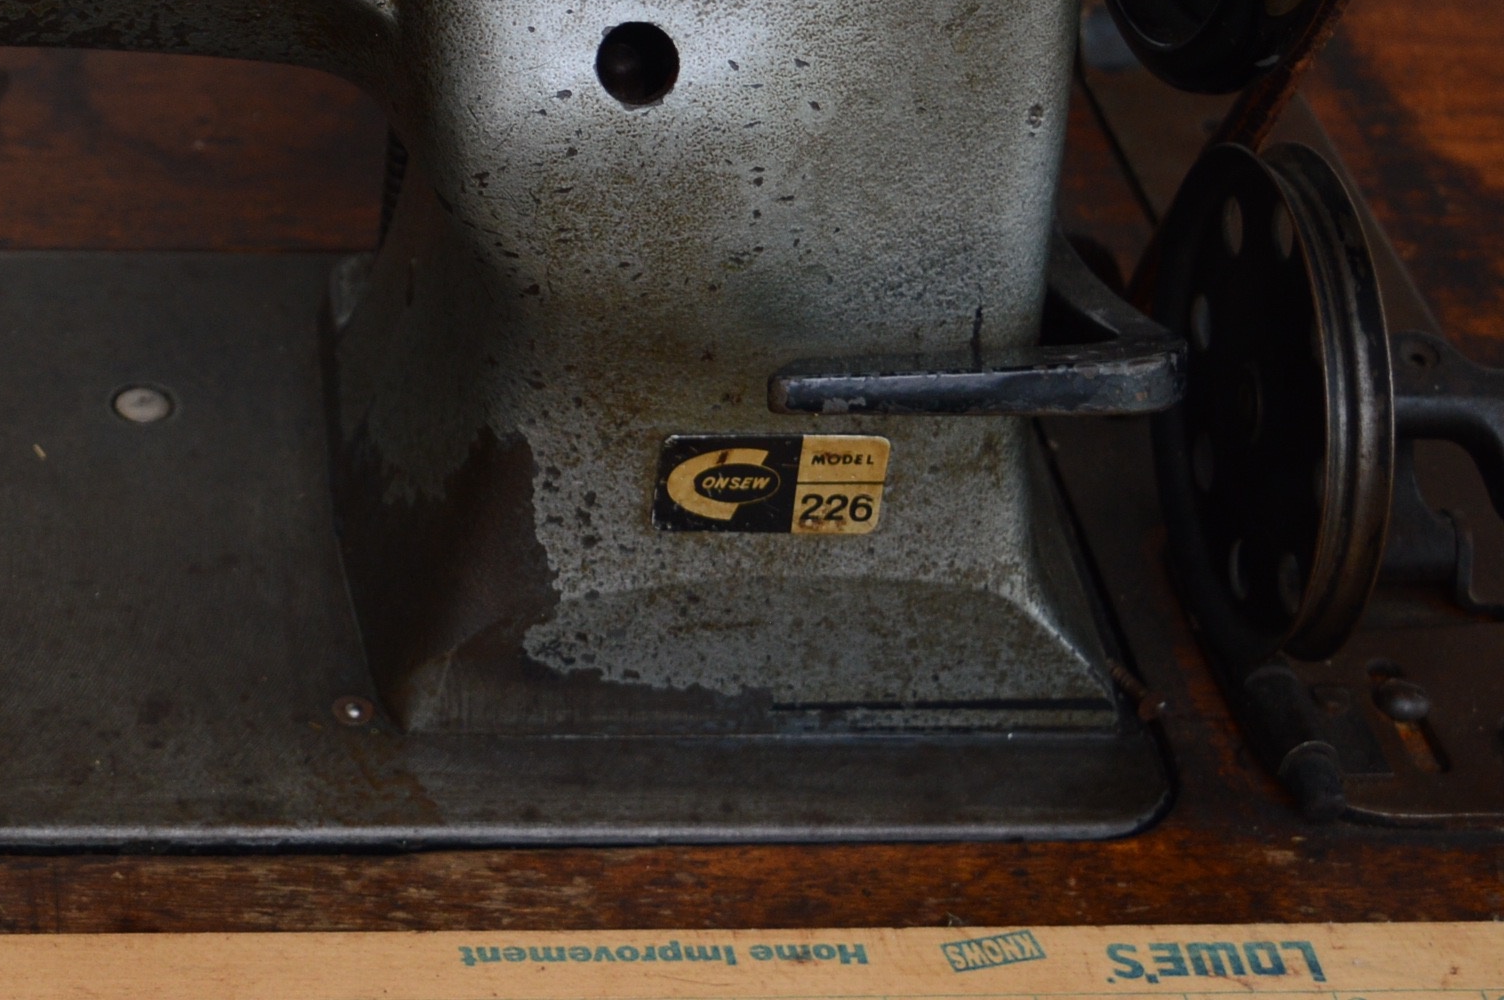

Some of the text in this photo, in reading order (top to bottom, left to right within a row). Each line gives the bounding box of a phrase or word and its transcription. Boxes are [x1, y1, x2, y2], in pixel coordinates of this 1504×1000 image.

[811, 453, 874, 466] MODEL
[799, 494, 873, 521] 226
[458, 932, 1327, 984] LOWE'S KNOWS Home Improvement
